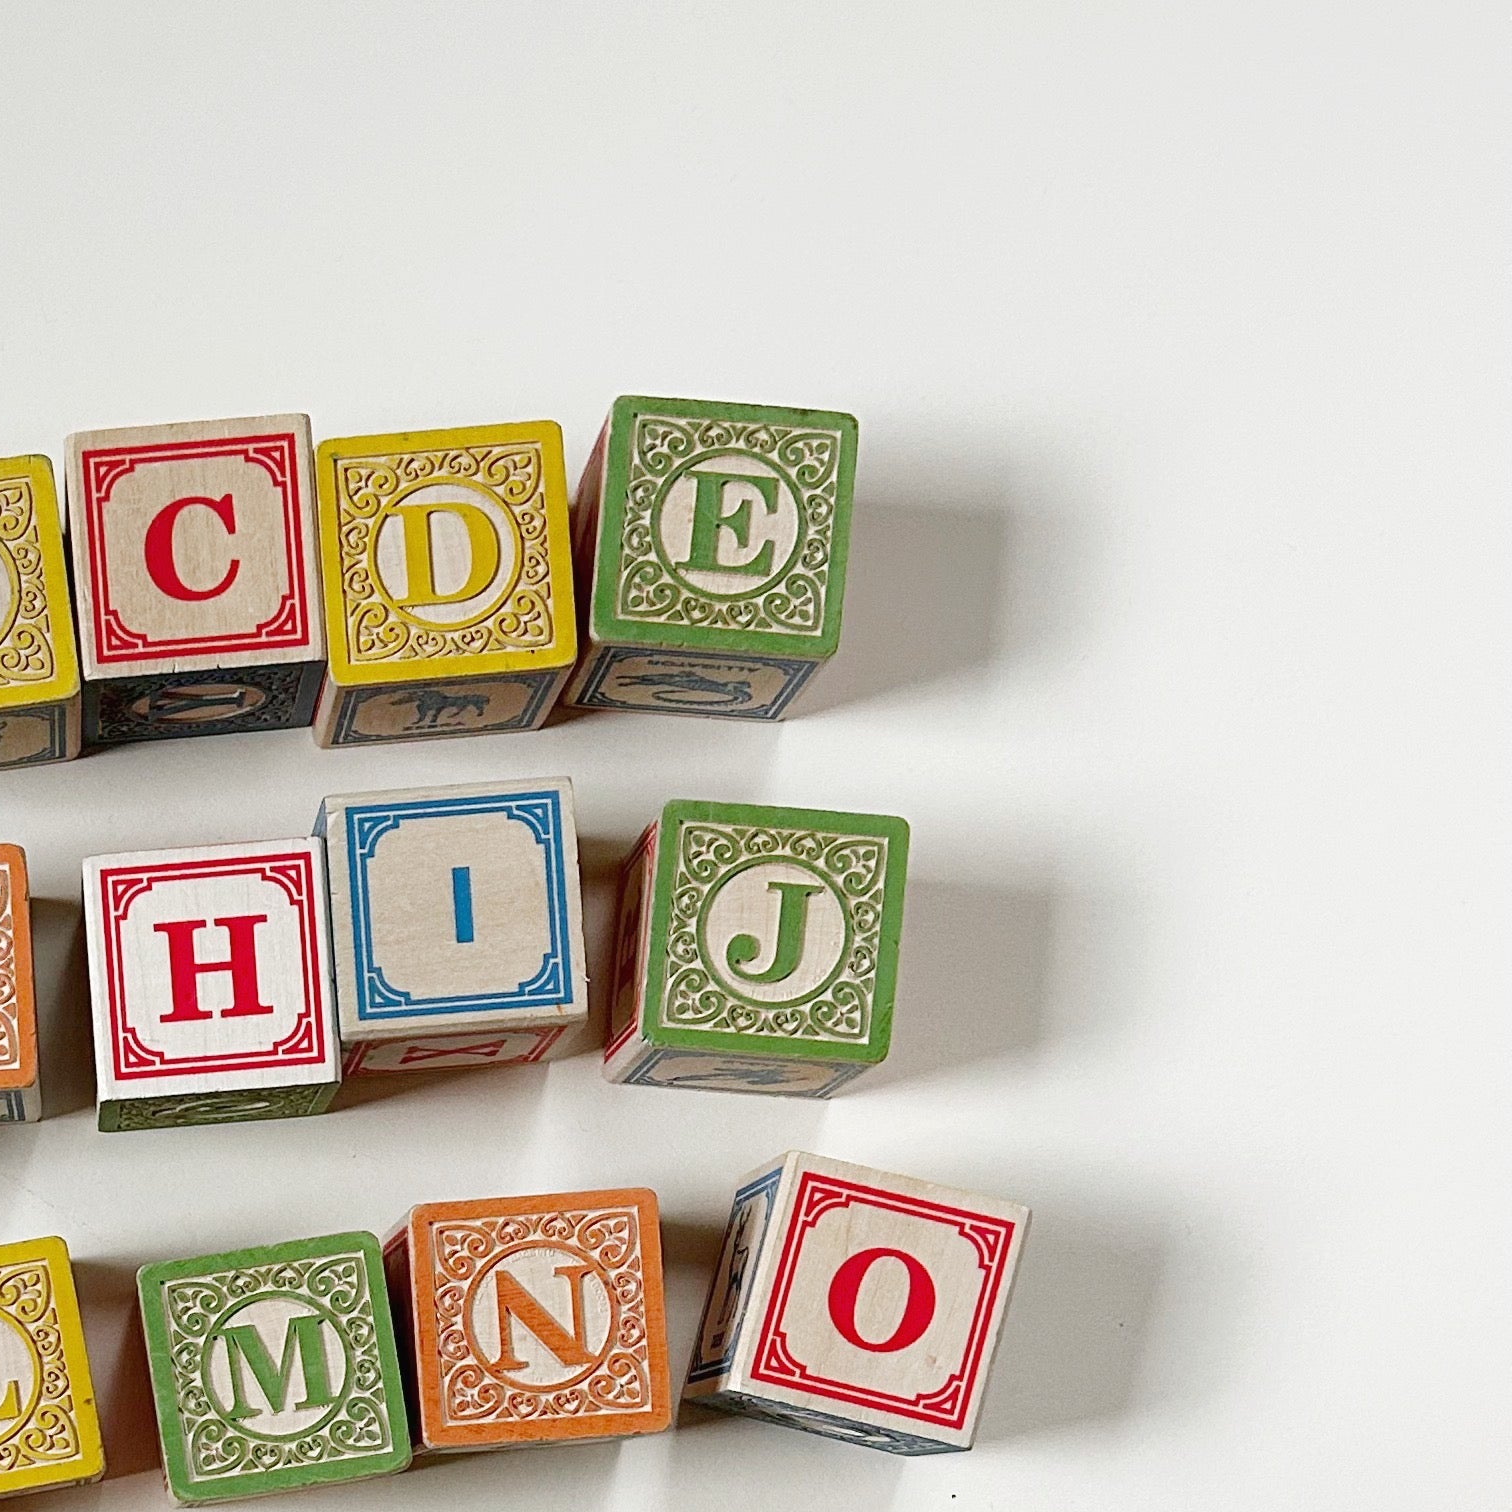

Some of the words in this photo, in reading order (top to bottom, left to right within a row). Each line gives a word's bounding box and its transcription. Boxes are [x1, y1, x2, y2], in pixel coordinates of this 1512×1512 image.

[143, 492, 241, 602] C
[384, 502, 500, 607] D
[674, 470, 779, 577] E
[152, 913, 274, 1024] H
[726, 881, 826, 985] J
[490, 1264, 598, 1372] N
[826, 1246, 937, 1354] O
[208, 1314, 339, 1421] M
